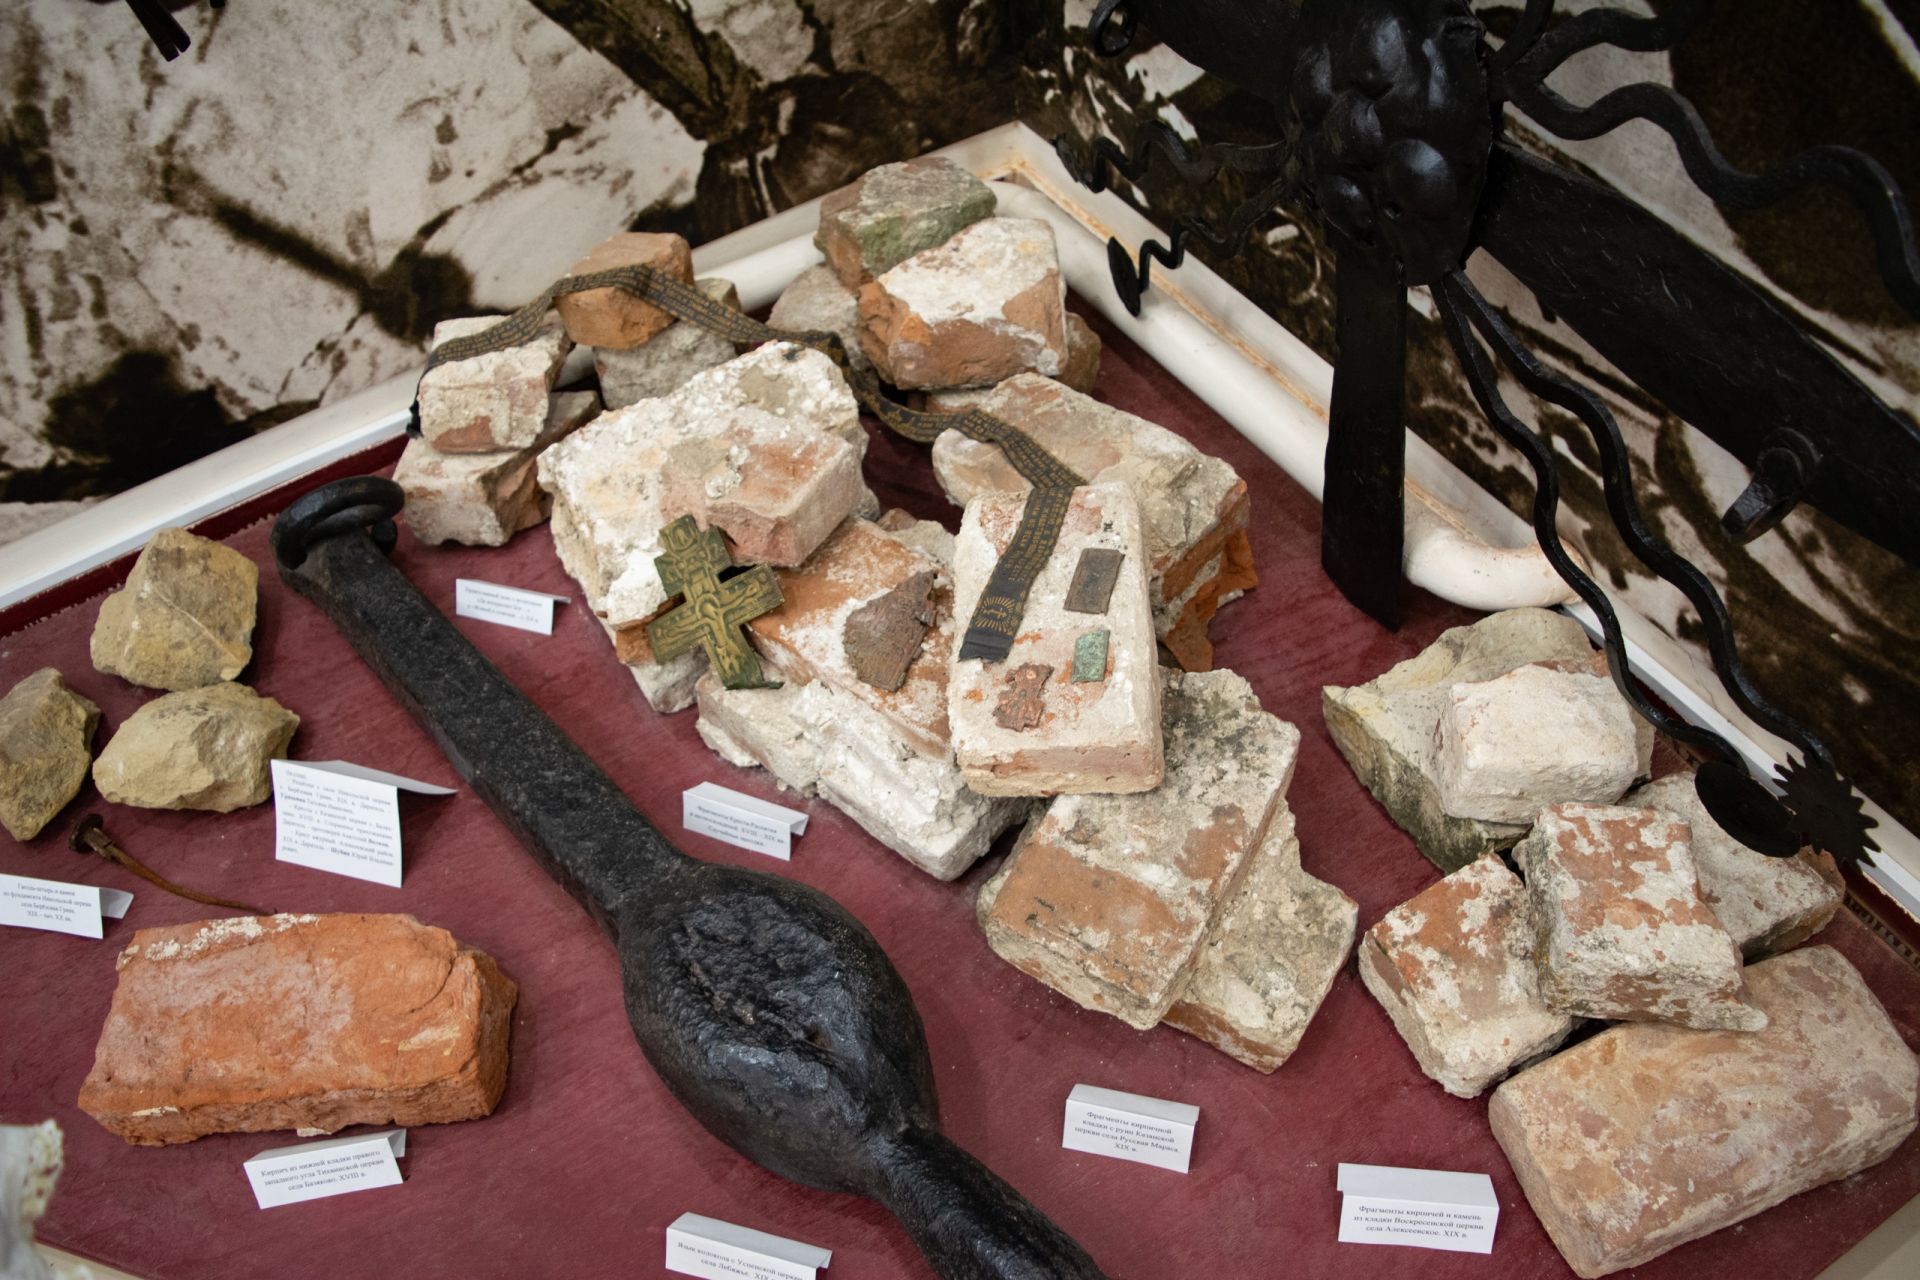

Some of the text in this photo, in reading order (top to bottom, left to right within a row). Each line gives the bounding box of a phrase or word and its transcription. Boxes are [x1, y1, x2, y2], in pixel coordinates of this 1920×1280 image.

[1087, 1112, 1129, 1125] Фрагменты
[1358, 1205, 1404, 1215] Фрагменты
[1406, 1209, 1444, 1218] кирпичей
[1394, 1216, 1454, 1228] Воскресенской
[1456, 1223, 1484, 1231] церкви
